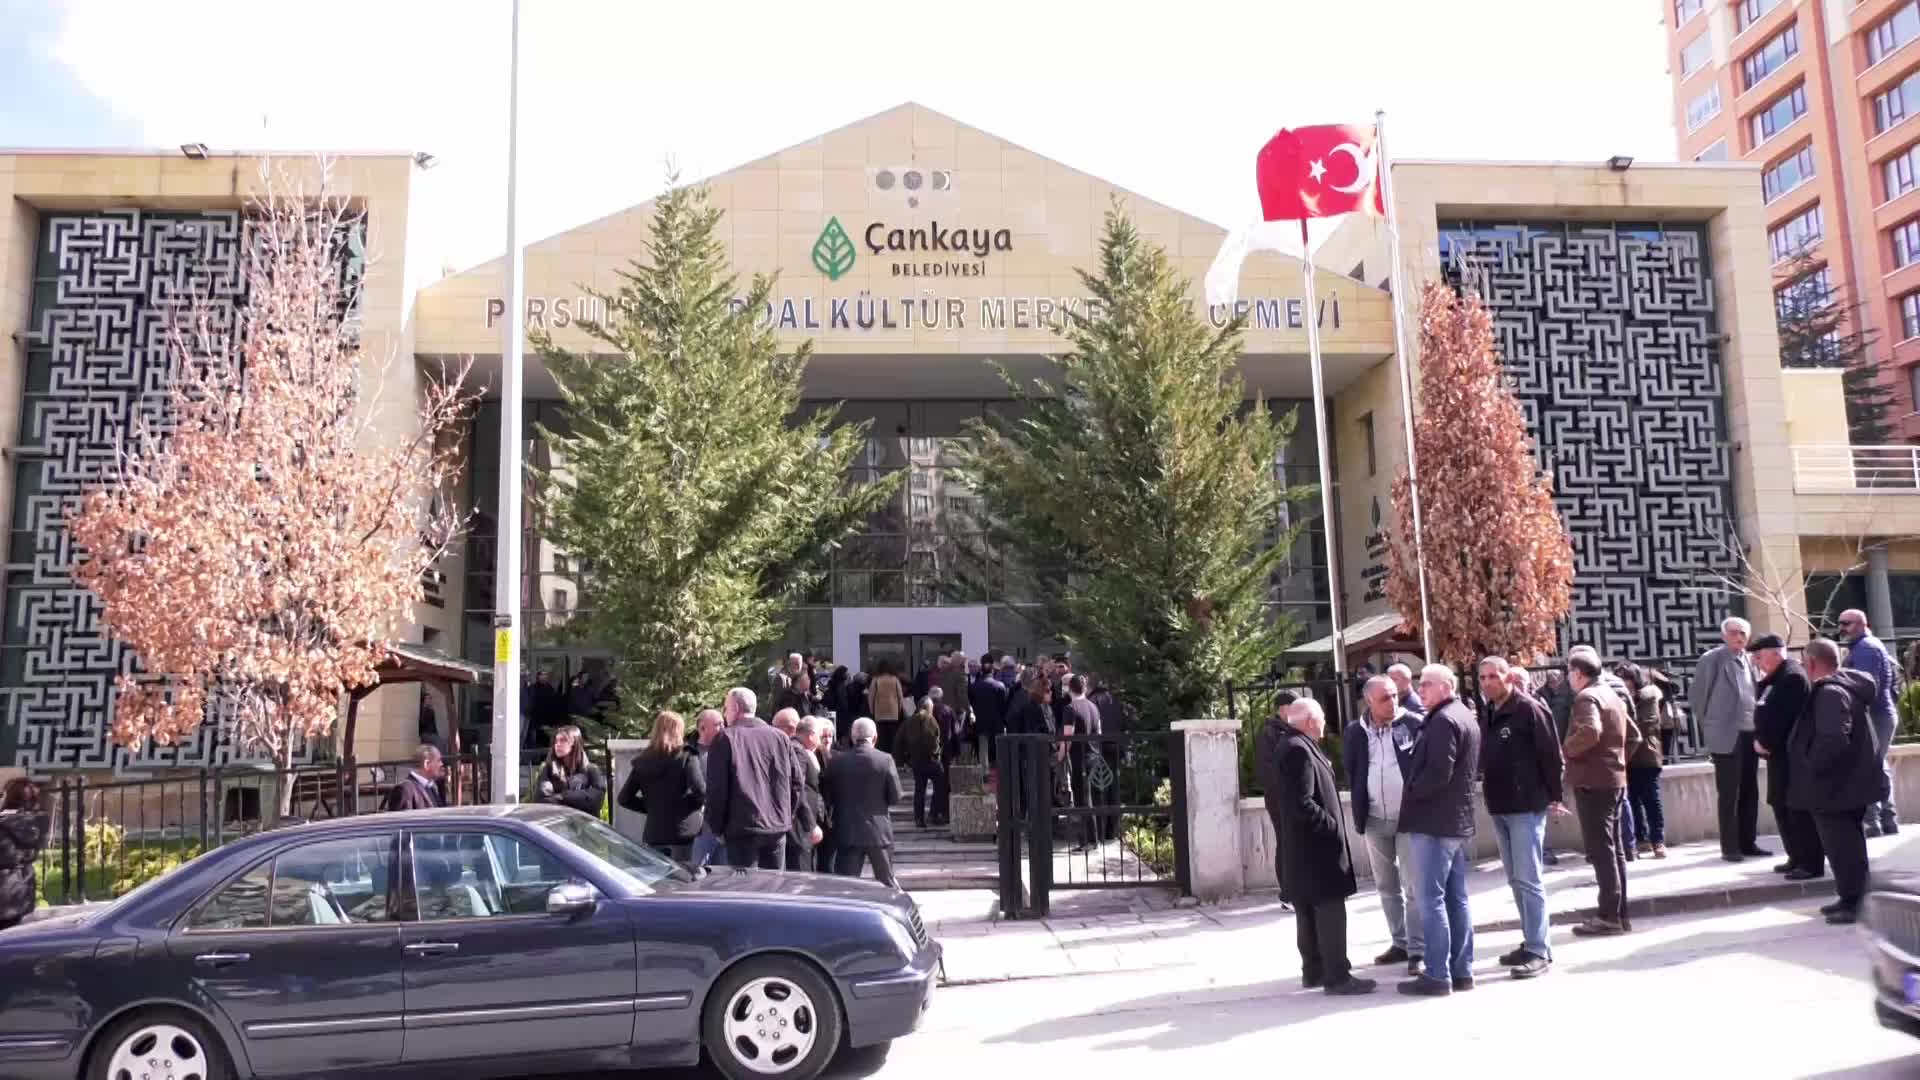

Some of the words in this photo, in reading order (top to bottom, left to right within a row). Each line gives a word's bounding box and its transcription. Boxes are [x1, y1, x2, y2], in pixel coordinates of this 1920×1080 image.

[865, 221, 1013, 257] Çankaya
[892, 261, 986, 277] BELEDİYESİ
[831, 289, 965, 329] KÜLTÜR
